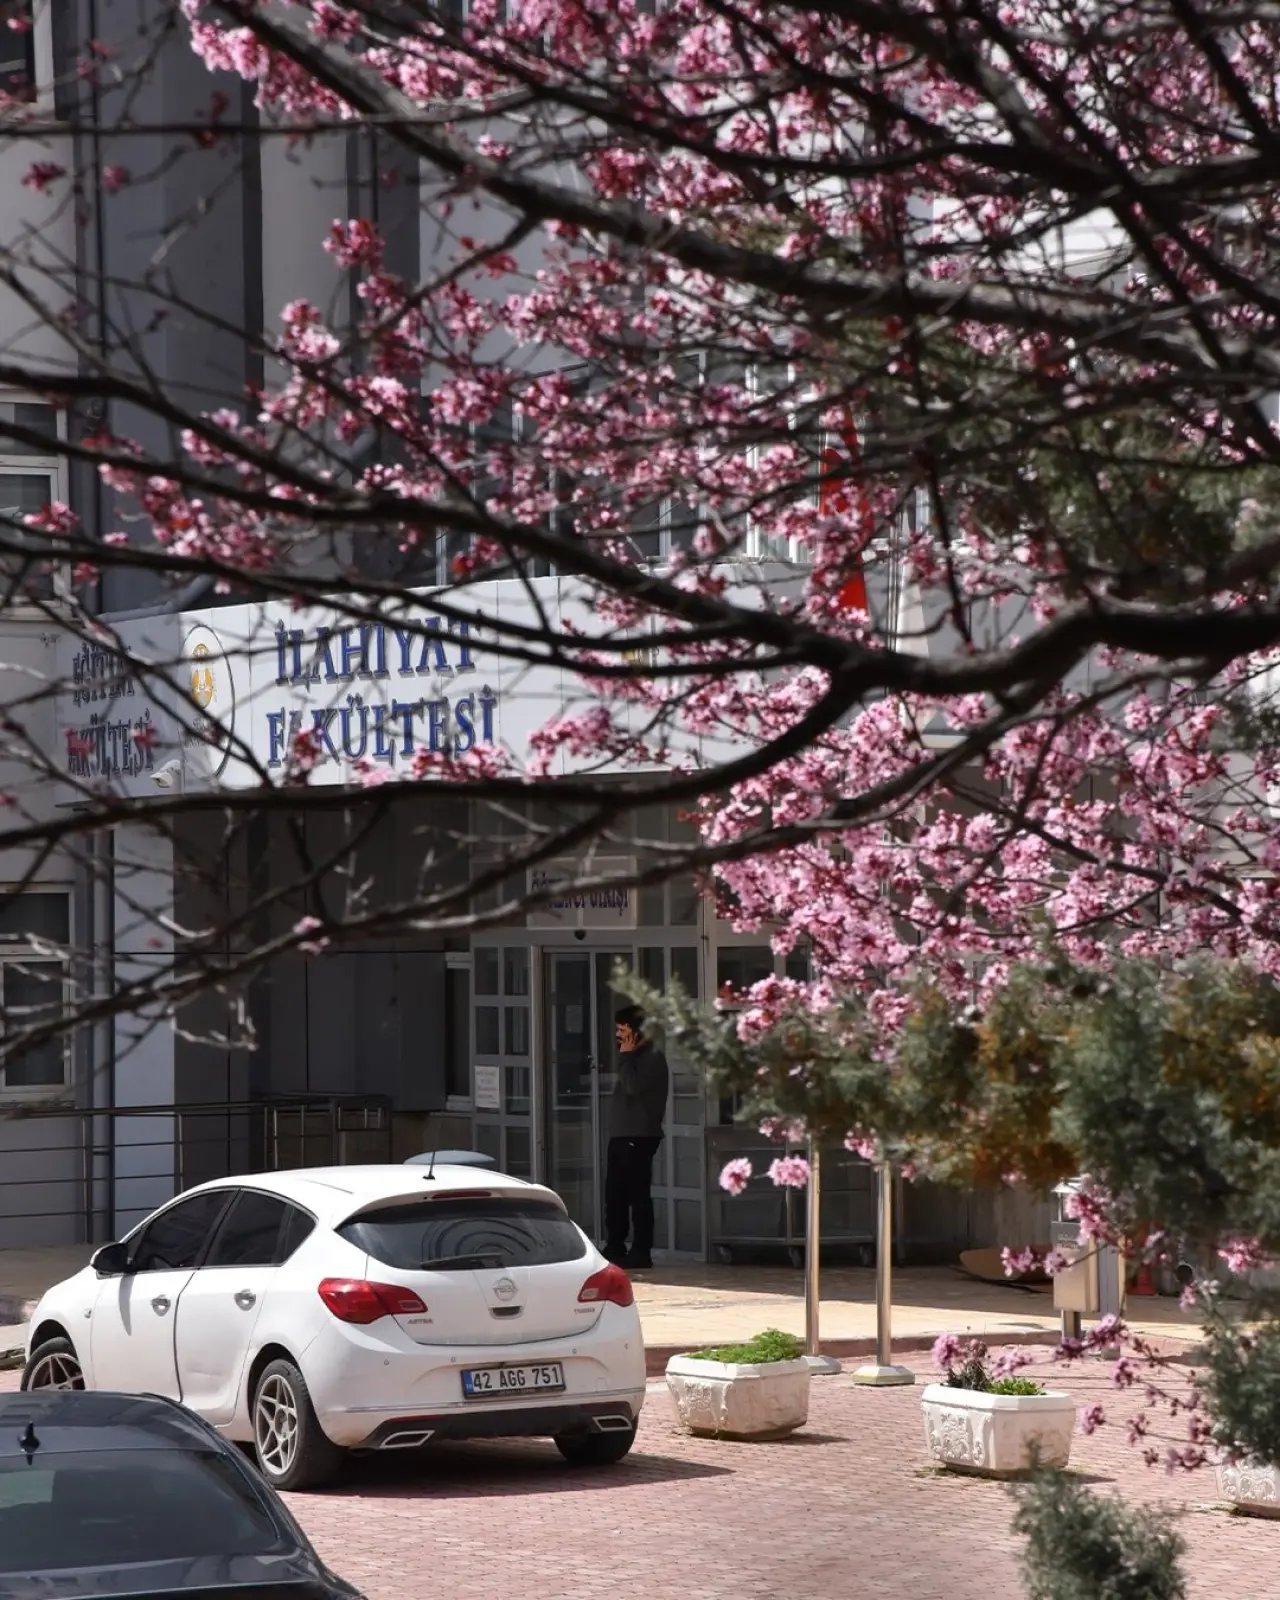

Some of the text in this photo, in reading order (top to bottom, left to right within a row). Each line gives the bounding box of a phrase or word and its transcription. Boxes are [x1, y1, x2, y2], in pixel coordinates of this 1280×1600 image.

[474, 1367, 559, 1389] 42 AGG 751
